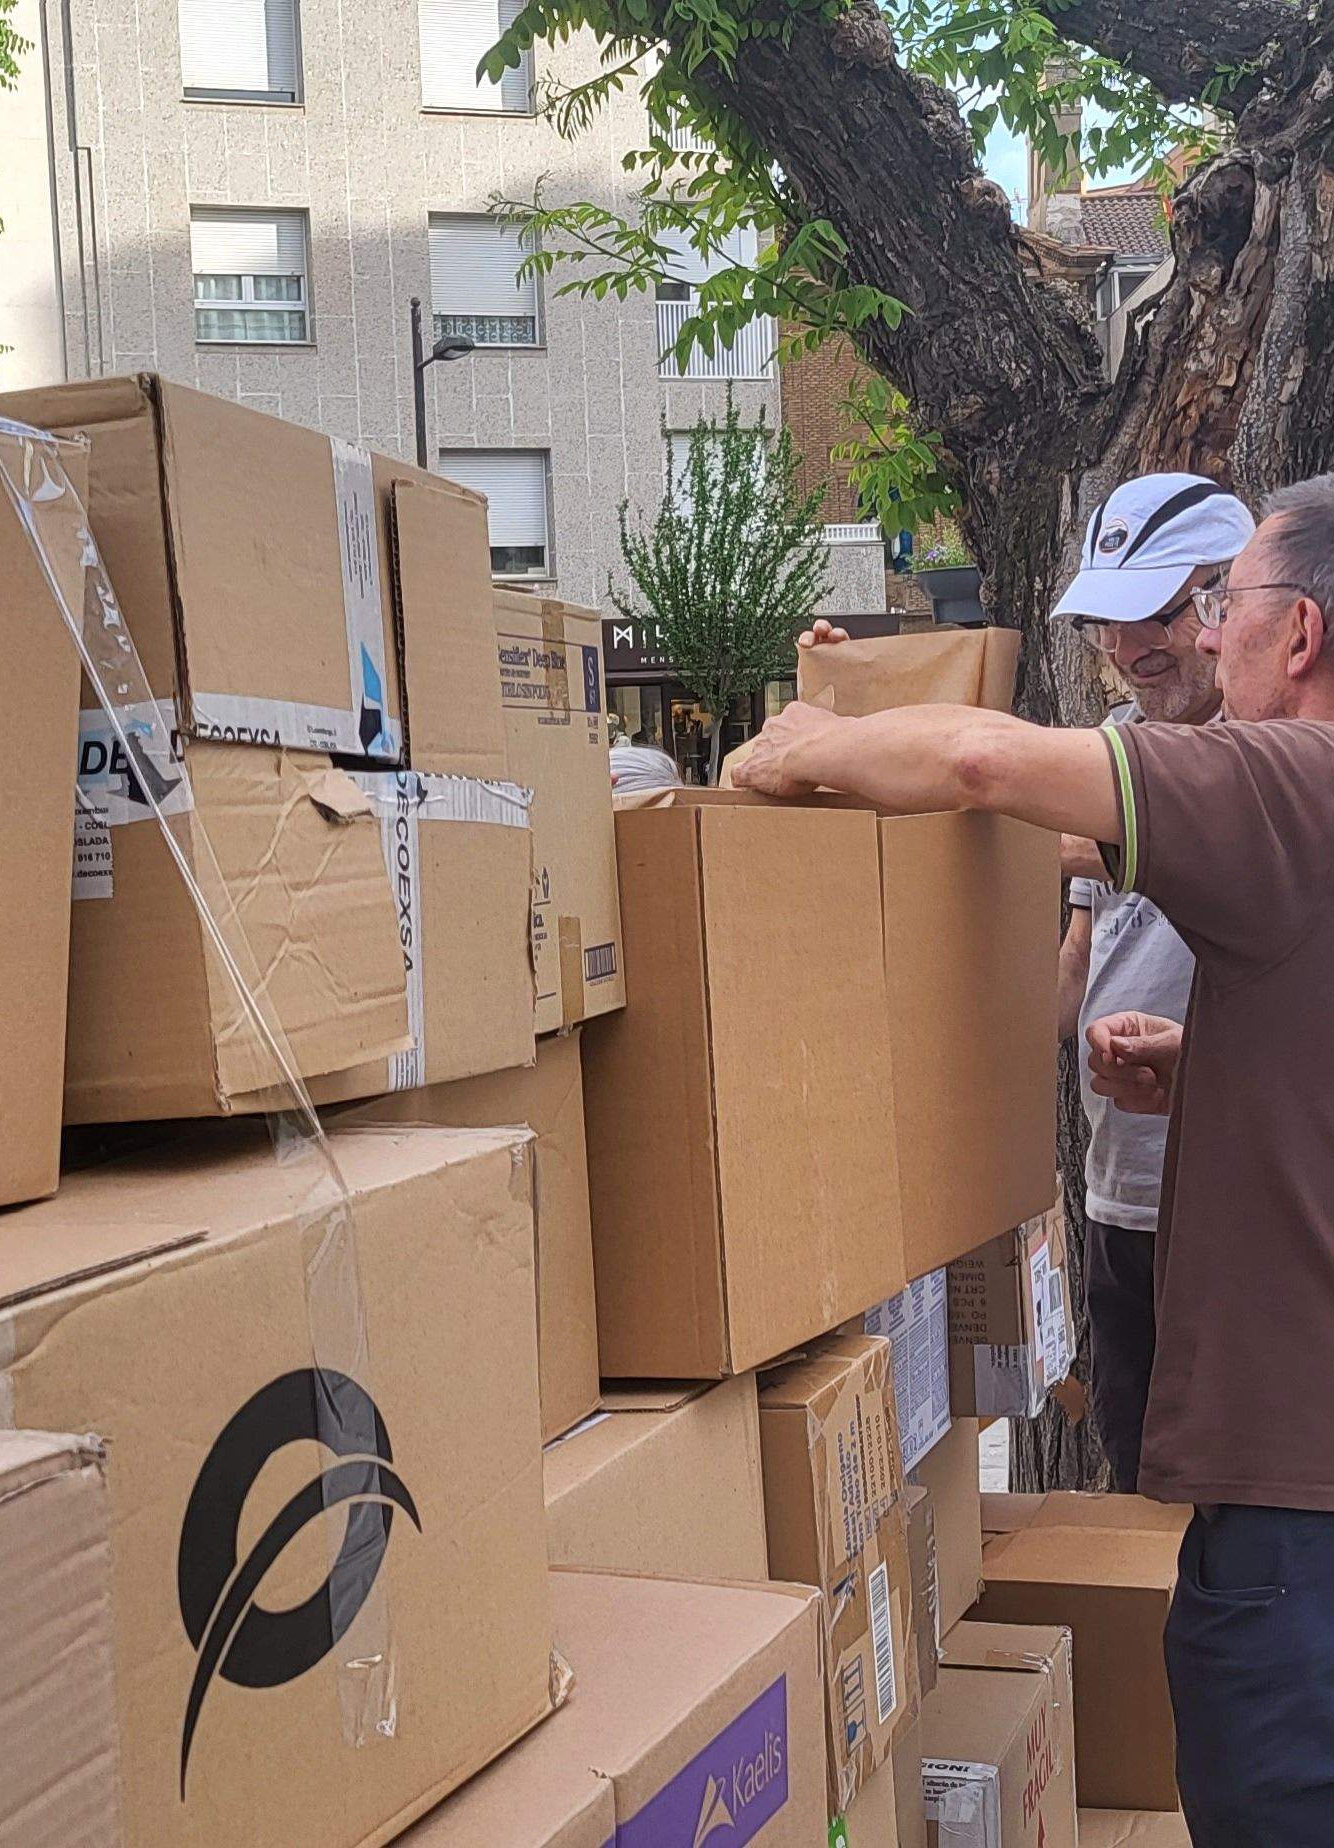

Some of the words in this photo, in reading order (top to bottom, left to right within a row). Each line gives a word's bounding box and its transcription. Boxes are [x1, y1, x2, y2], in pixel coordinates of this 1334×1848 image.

[395, 771, 414, 972] DECOEXSA
[732, 1730, 782, 1815] Kaelis
[1026, 1701, 1047, 1773] MUY
[1022, 1740, 1054, 1830] FRAGIL
